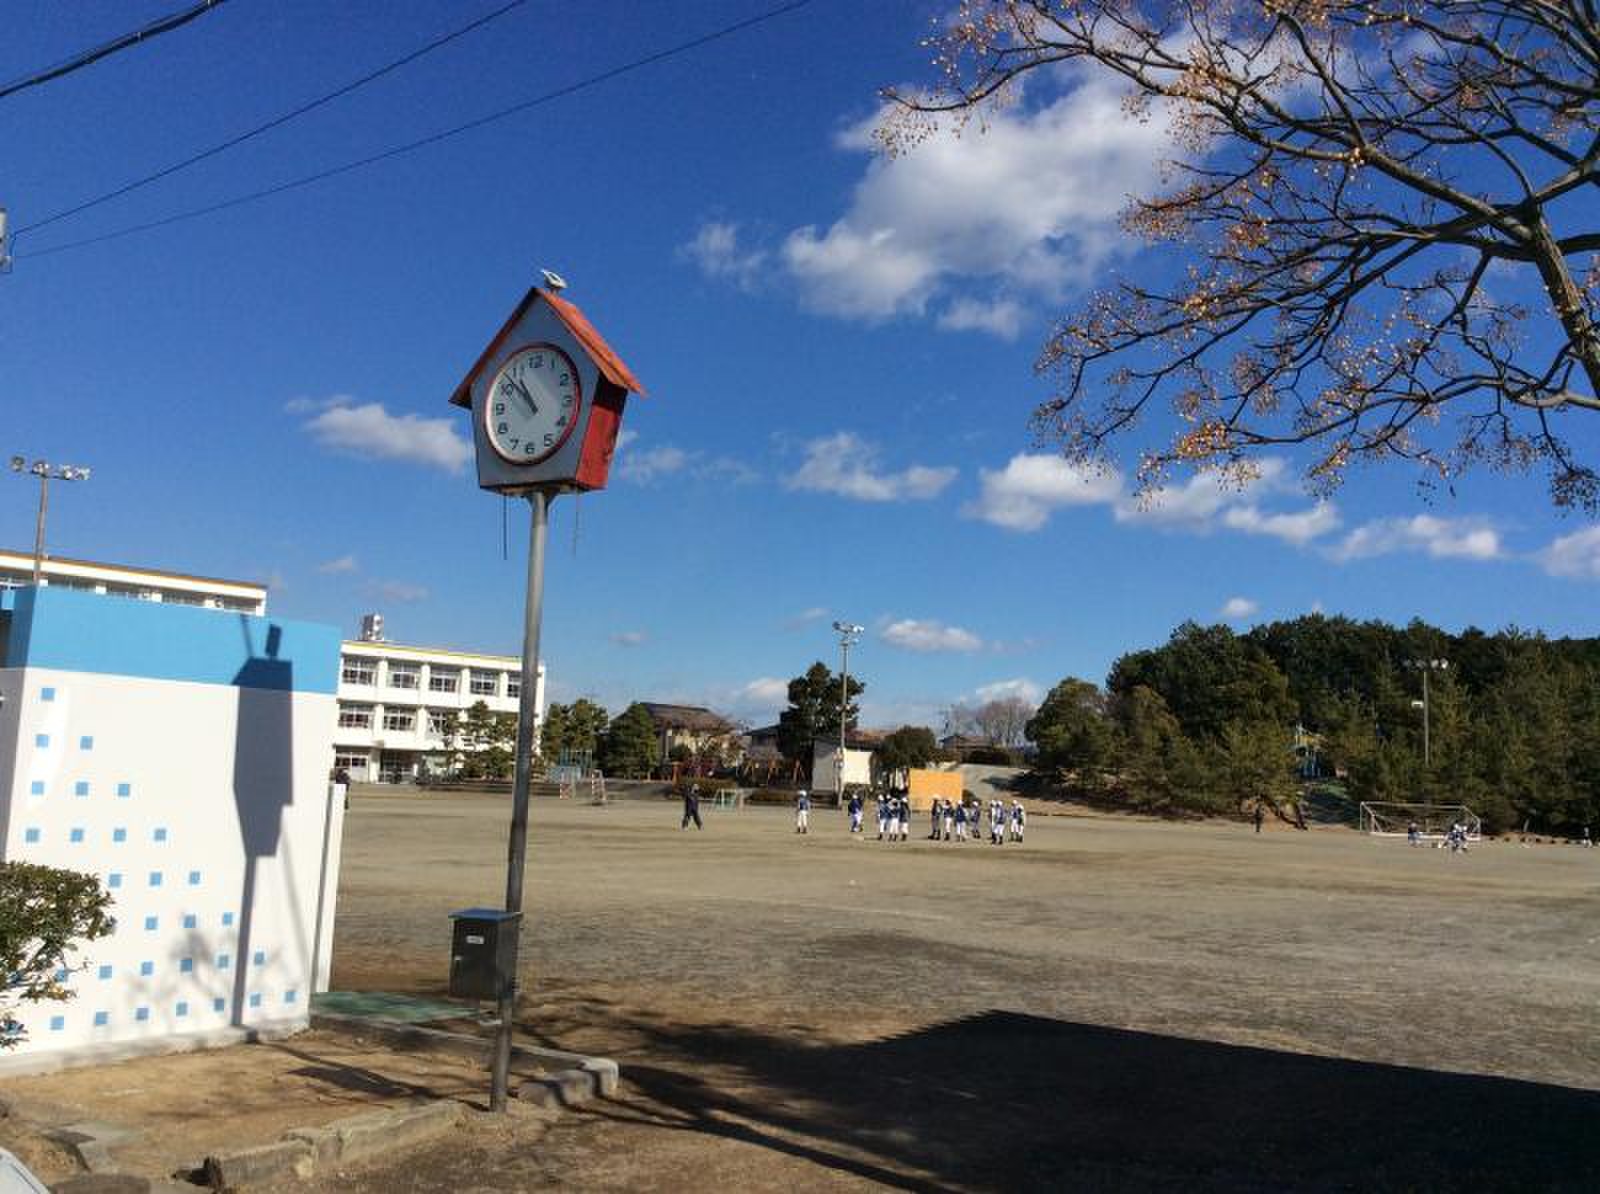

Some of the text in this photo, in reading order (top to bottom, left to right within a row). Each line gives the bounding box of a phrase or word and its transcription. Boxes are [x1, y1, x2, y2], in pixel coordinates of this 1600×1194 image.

[528, 355, 544, 369] 12
[560, 373, 569, 386] 2
[495, 403, 505, 415] 9
[556, 416, 566, 427] 4
[497, 422, 508, 434] 8
[510, 439, 519, 450] 7
[544, 433, 553, 447] 5
[525, 443, 535, 454] 6
